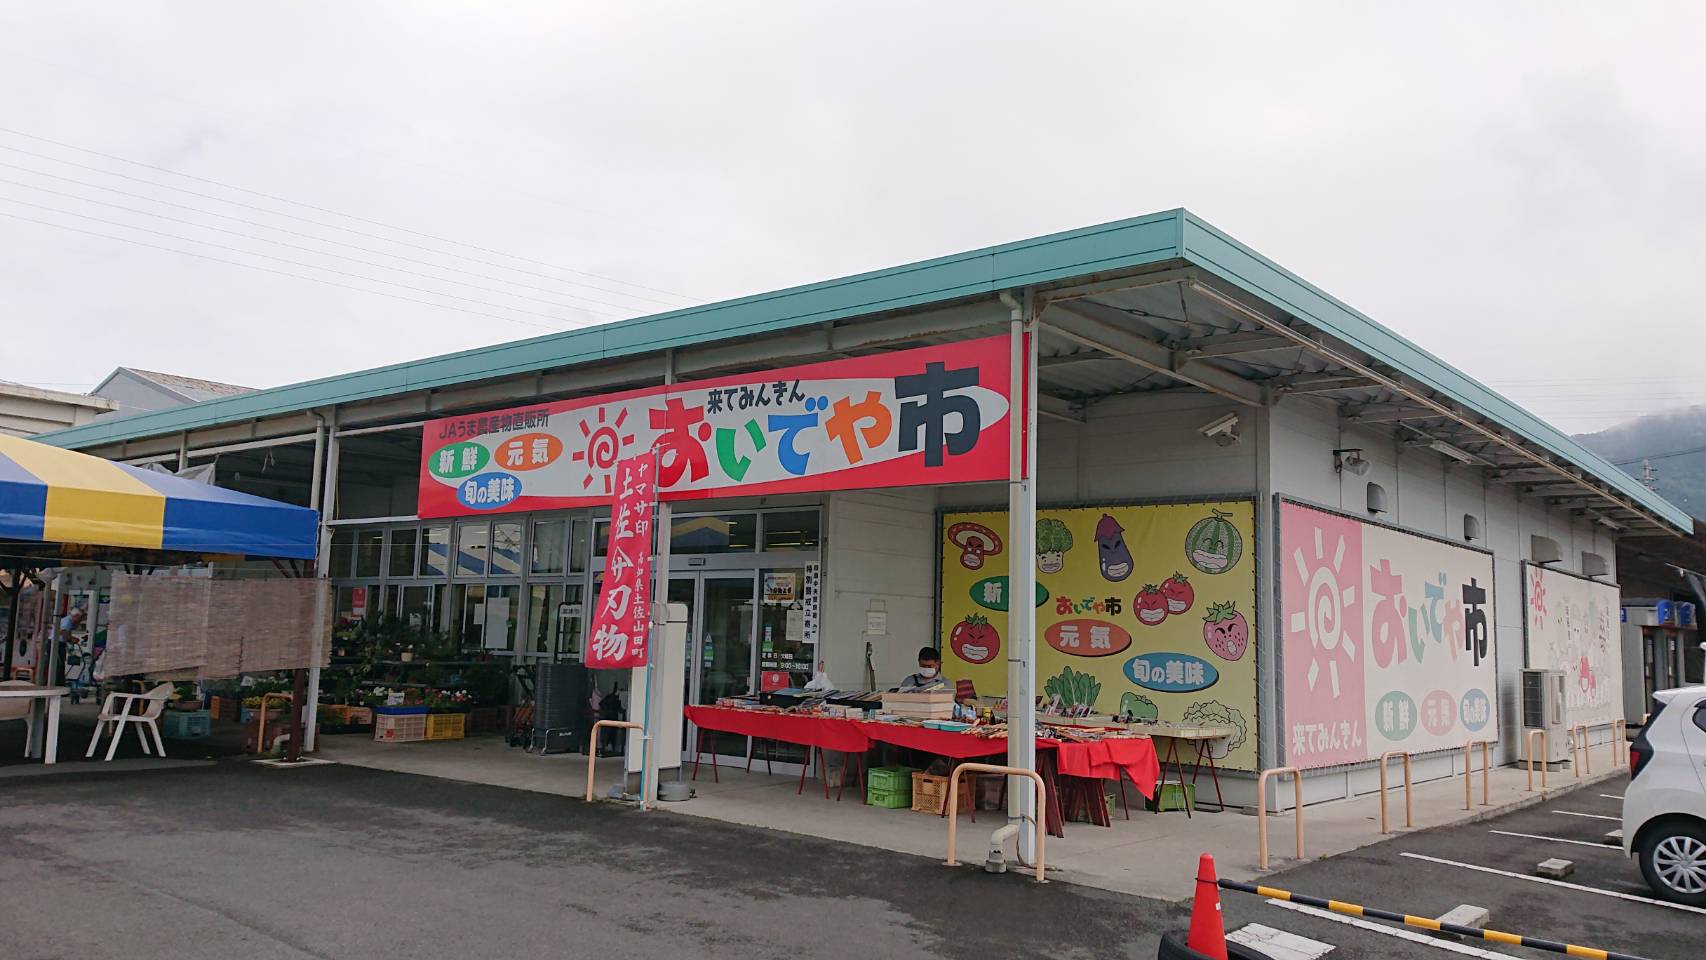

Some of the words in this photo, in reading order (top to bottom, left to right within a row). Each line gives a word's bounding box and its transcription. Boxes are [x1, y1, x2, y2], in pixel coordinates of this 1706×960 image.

[706, 379, 806, 414] 来てみんきん
[439, 408, 550, 439] JAうま農産物直販所
[649, 361, 981, 491] おいでや市
[438, 446, 479, 474] 新鮮
[506, 438, 549, 467] 元気
[464, 476, 516, 506] 旬の美味
[1055, 595, 1122, 617] おいでや市
[1369, 558, 1488, 668] おいでや市
[1059, 625, 1111, 649] 元気
[1132, 659, 1205, 685] 旬の美味
[1292, 718, 1362, 757] 来てみんきん
